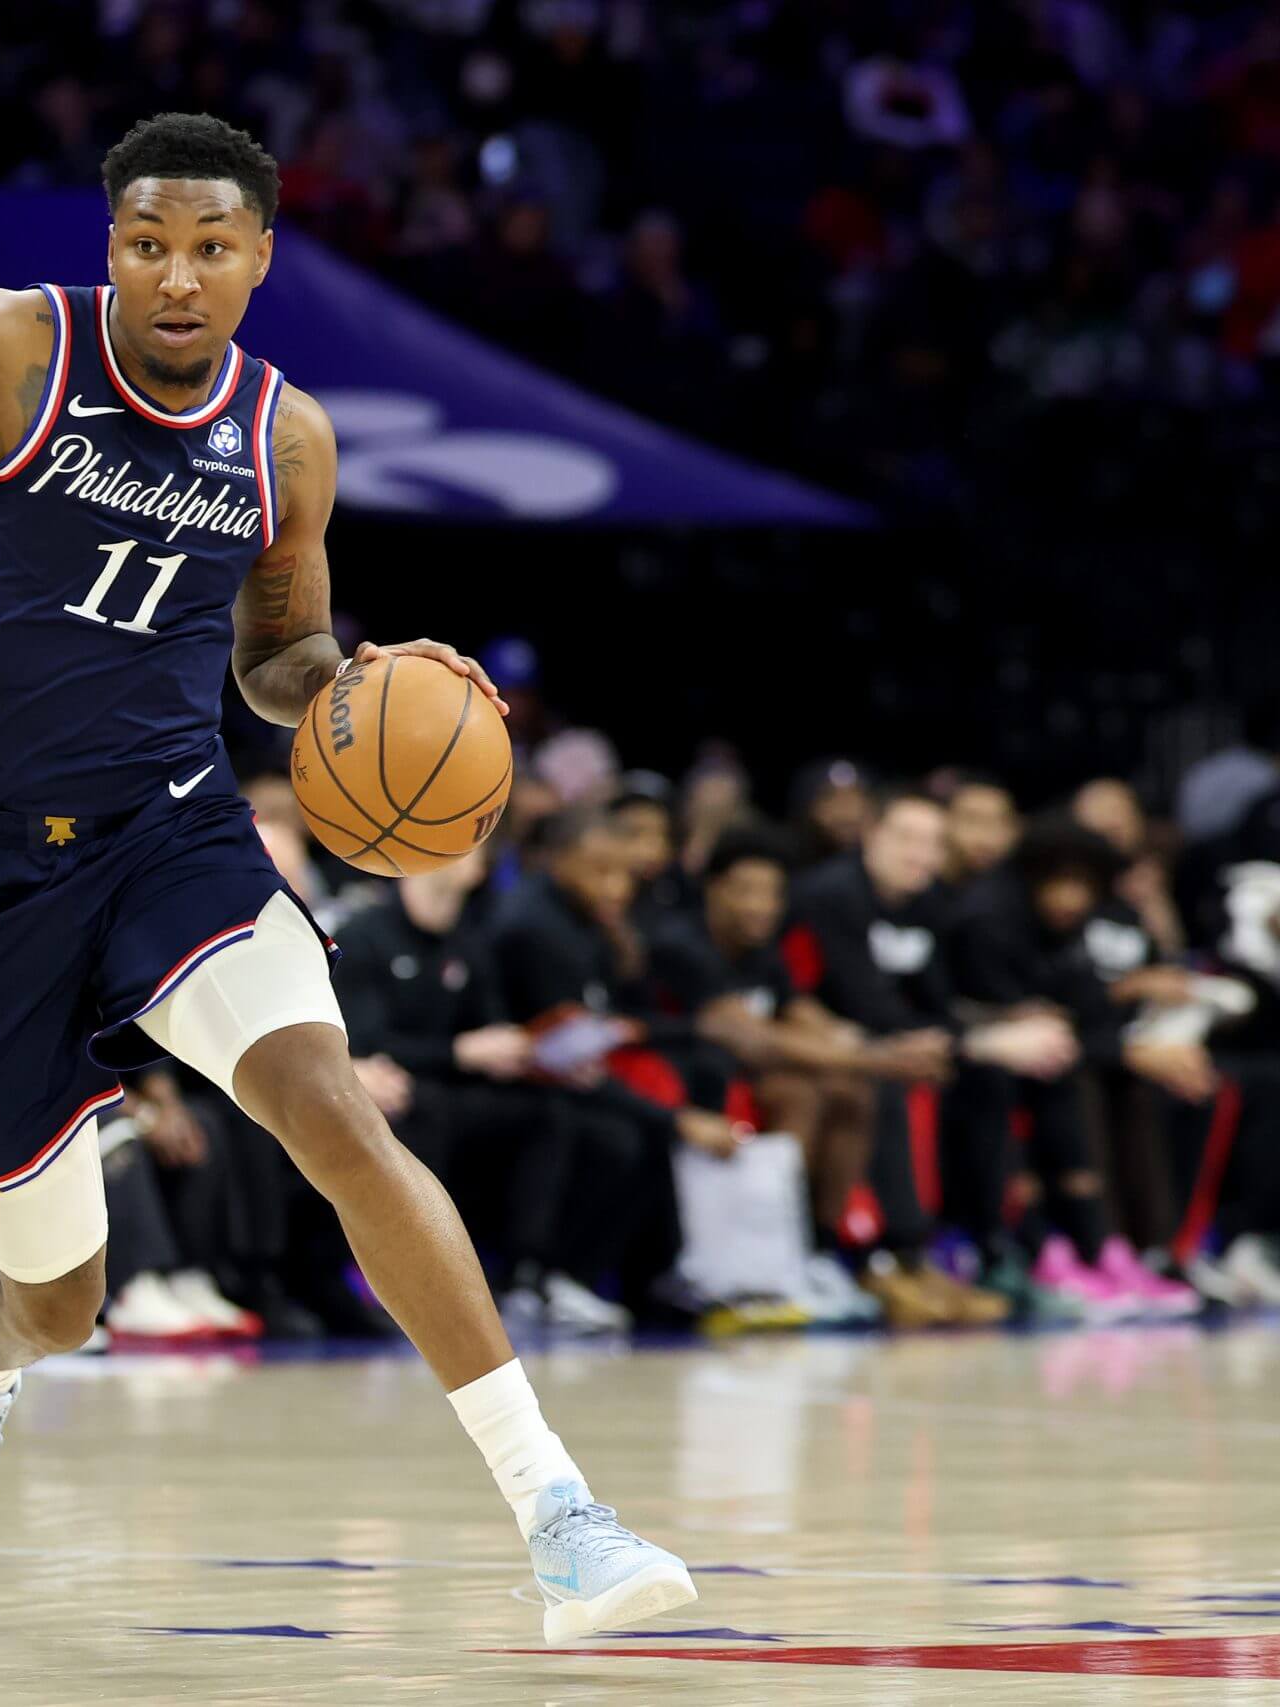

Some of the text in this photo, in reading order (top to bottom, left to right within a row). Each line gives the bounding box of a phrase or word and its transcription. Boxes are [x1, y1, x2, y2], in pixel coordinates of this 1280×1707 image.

[28, 434, 261, 542] Philadelphia
[192, 458, 255, 478] crypto.com
[63, 539, 188, 634] 11
